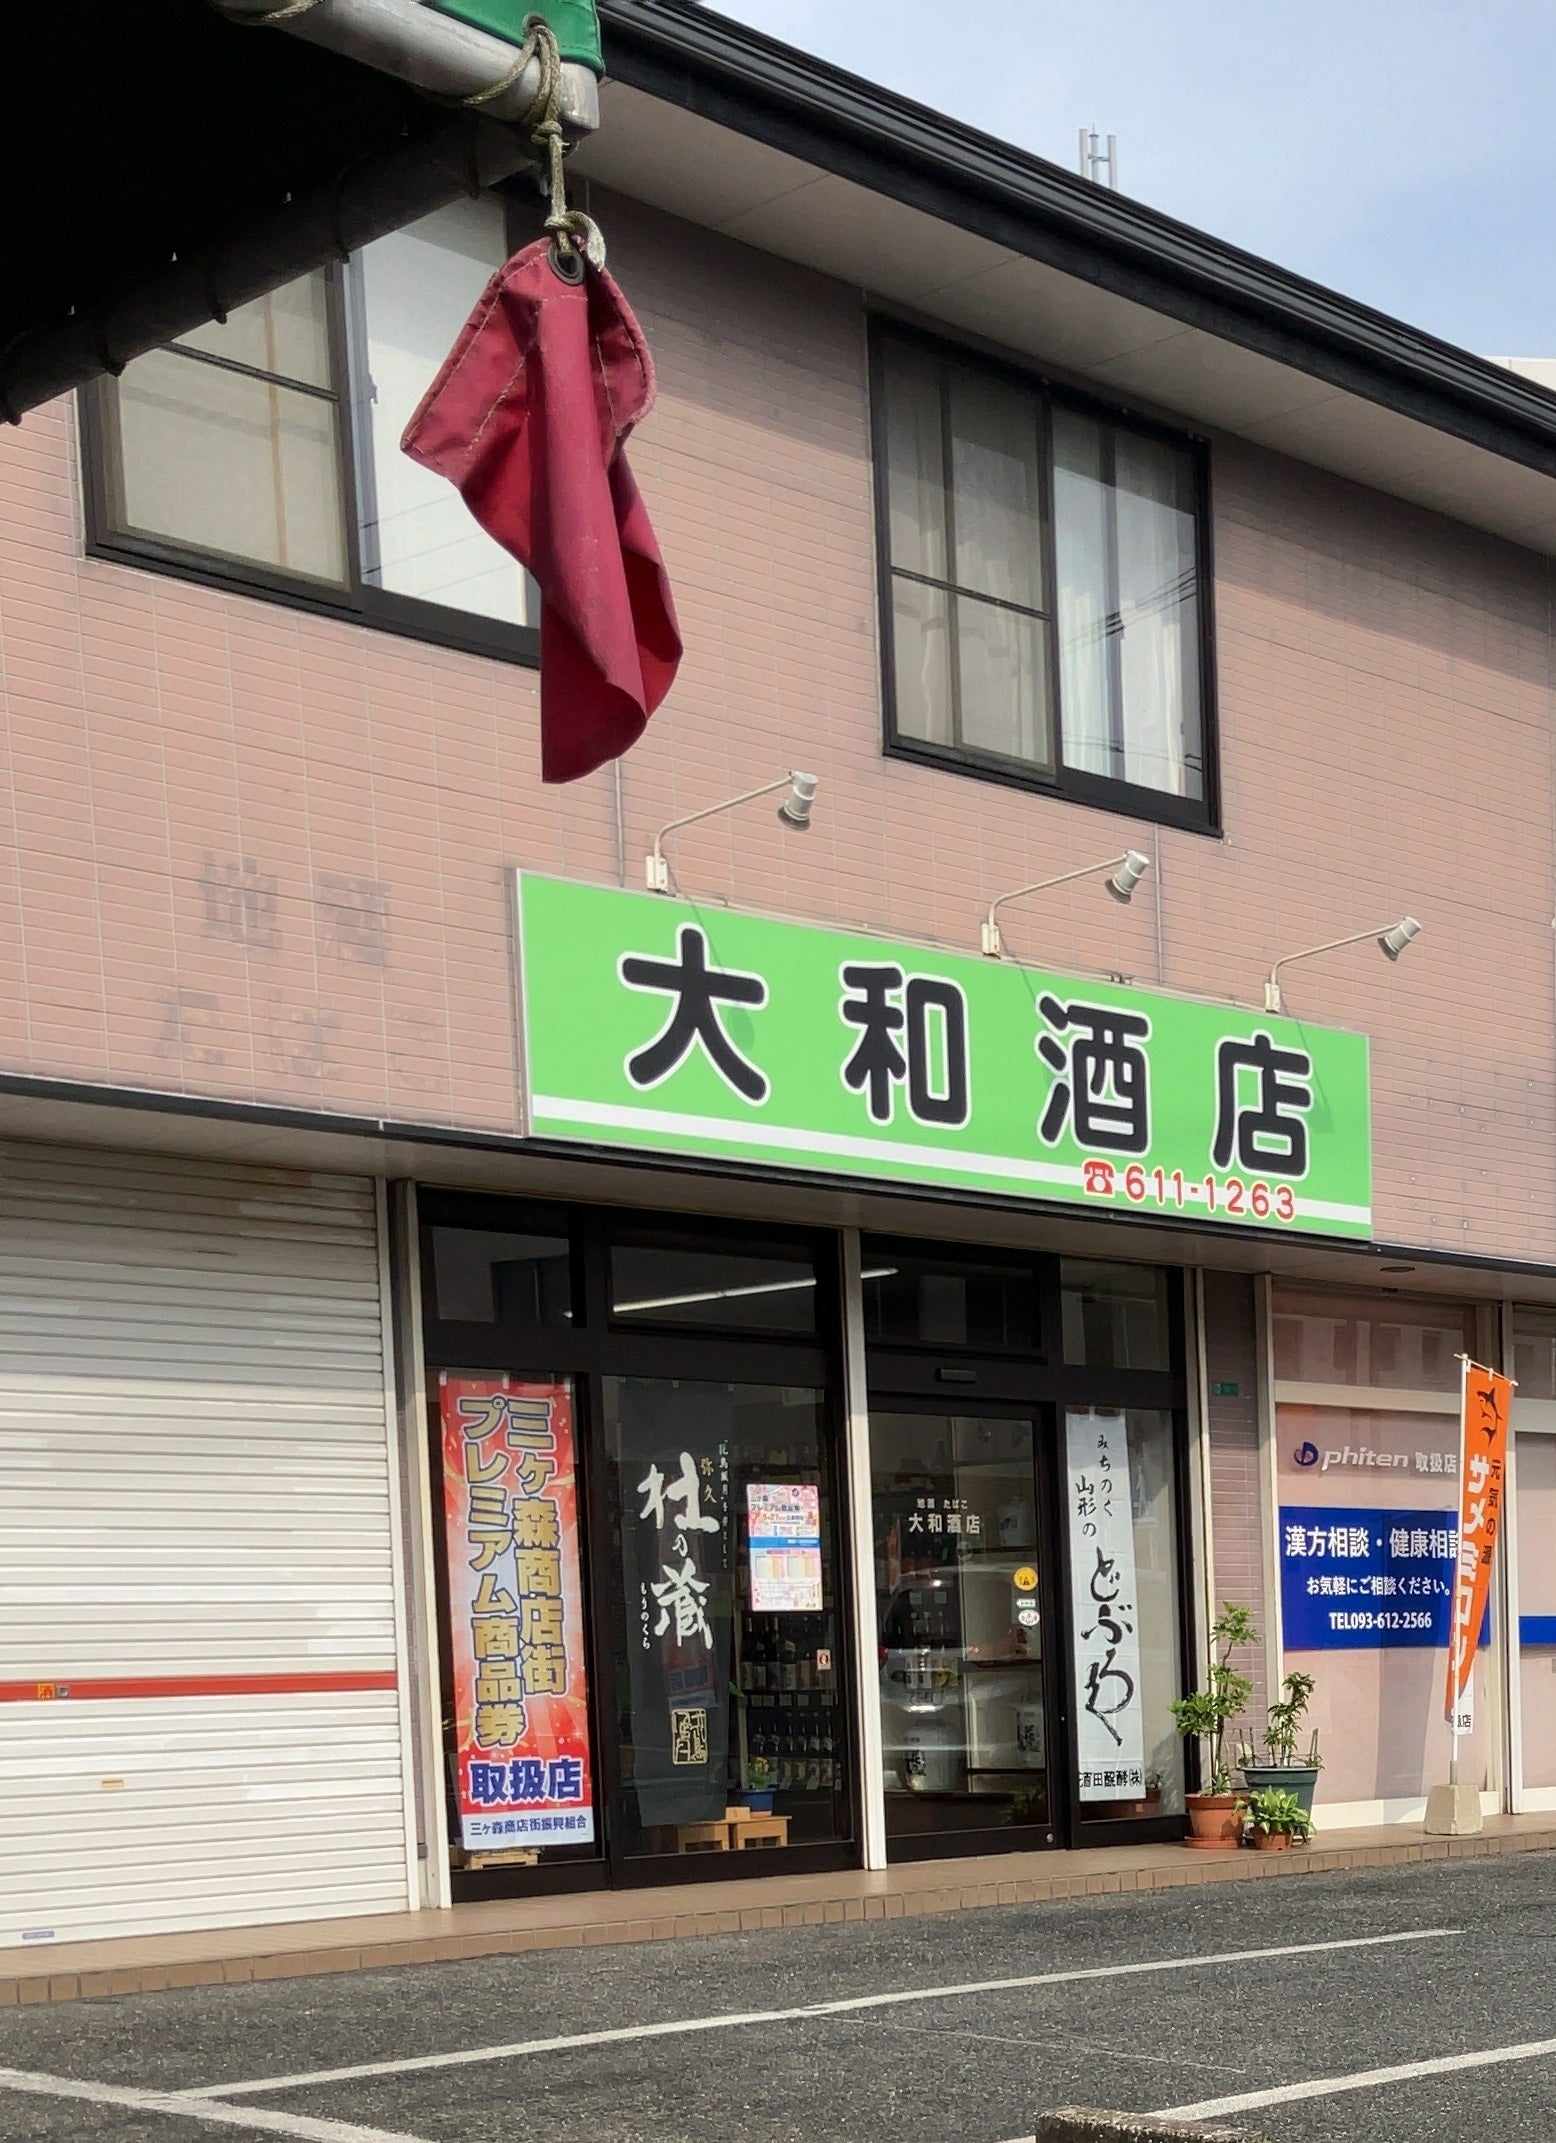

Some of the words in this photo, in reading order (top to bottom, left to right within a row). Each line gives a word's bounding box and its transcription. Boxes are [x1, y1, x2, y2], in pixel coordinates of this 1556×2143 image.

[617, 921, 1313, 1179] 大和酒店
[1125, 1165, 1295, 1220] 611-1263
[1097, 1434, 1113, 1517] みちのく
[1321, 1445, 1409, 1471] phiten
[1415, 1452, 1457, 1473] 取扱店
[907, 1512, 981, 1535] 大和酒店
[943, 1498, 968, 1510] たばこ
[1075, 1475, 1097, 1537] 山形の
[458, 1394, 528, 1749] プレミアム商品券
[1306, 1575, 1451, 1596] お気軽にご相談ください。
[468, 1755, 584, 1806] 取扱店
